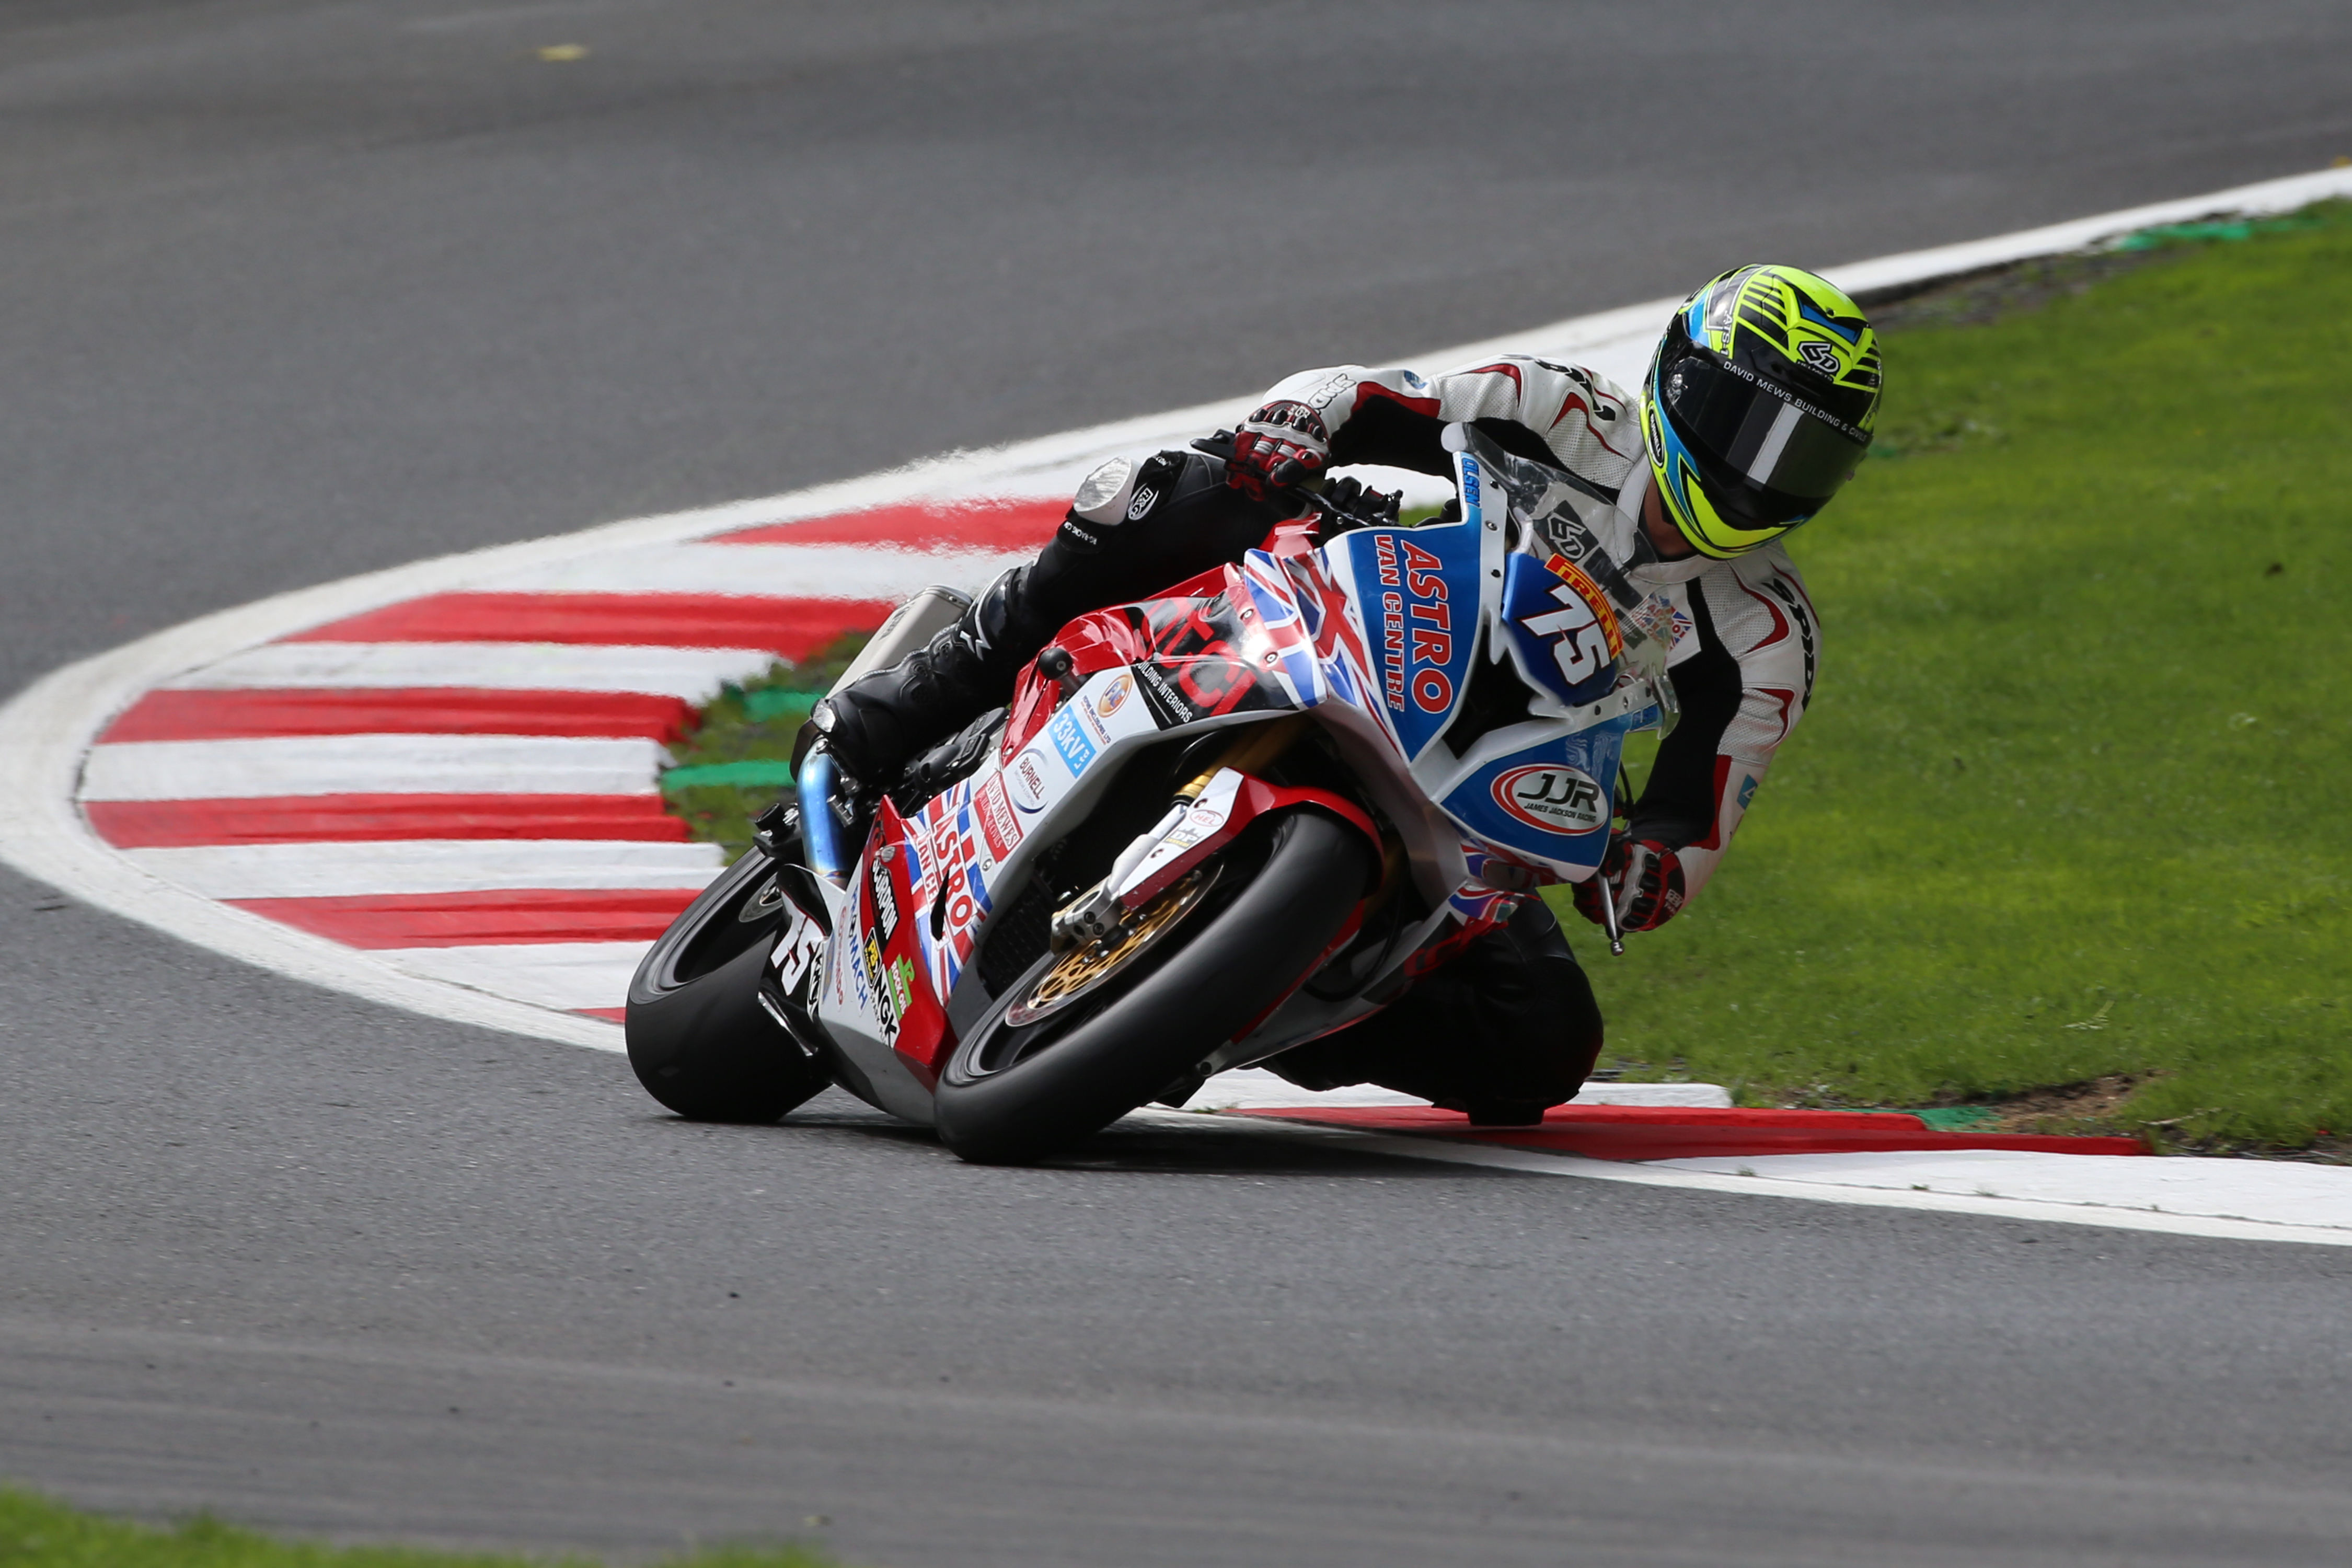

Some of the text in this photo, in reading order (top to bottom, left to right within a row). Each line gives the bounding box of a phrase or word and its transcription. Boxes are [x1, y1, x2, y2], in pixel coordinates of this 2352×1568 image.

[1723, 361, 1754, 382] DAVID
[1756, 378, 1792, 402] MEWS
[1794, 398, 1841, 426] BUILDING
[1849, 427, 1867, 442] CIVILS
[1462, 457, 1481, 508] OLSEN
[1374, 535, 1405, 712] VAN CENTRE
[1401, 539, 1453, 714] ASTRO
[1544, 552, 1623, 661] PIRELLI
[1518, 582, 1612, 688] 75
[1157, 682, 1193, 723] INTERIORS
[1054, 713, 1090, 770] 33kV Ltd
[1019, 756, 1045, 800] BURNELL
[1517, 773, 1600, 813] JJR
[989, 823, 1004, 848] CIVILS
[994, 800, 1020, 847] MEWES
[1171, 831, 1199, 842] DP
[1194, 814, 1215, 825] HEL
[1524, 803, 1597, 823] JAMES JACKSON RACING
[934, 813, 973, 928] ASTRO
[871, 857, 898, 940] SCORPION
[770, 891, 828, 996] 75
[868, 939, 879, 967] PB
[873, 968, 897, 1049] NGK
[891, 960, 908, 1015] ROCK OIL
